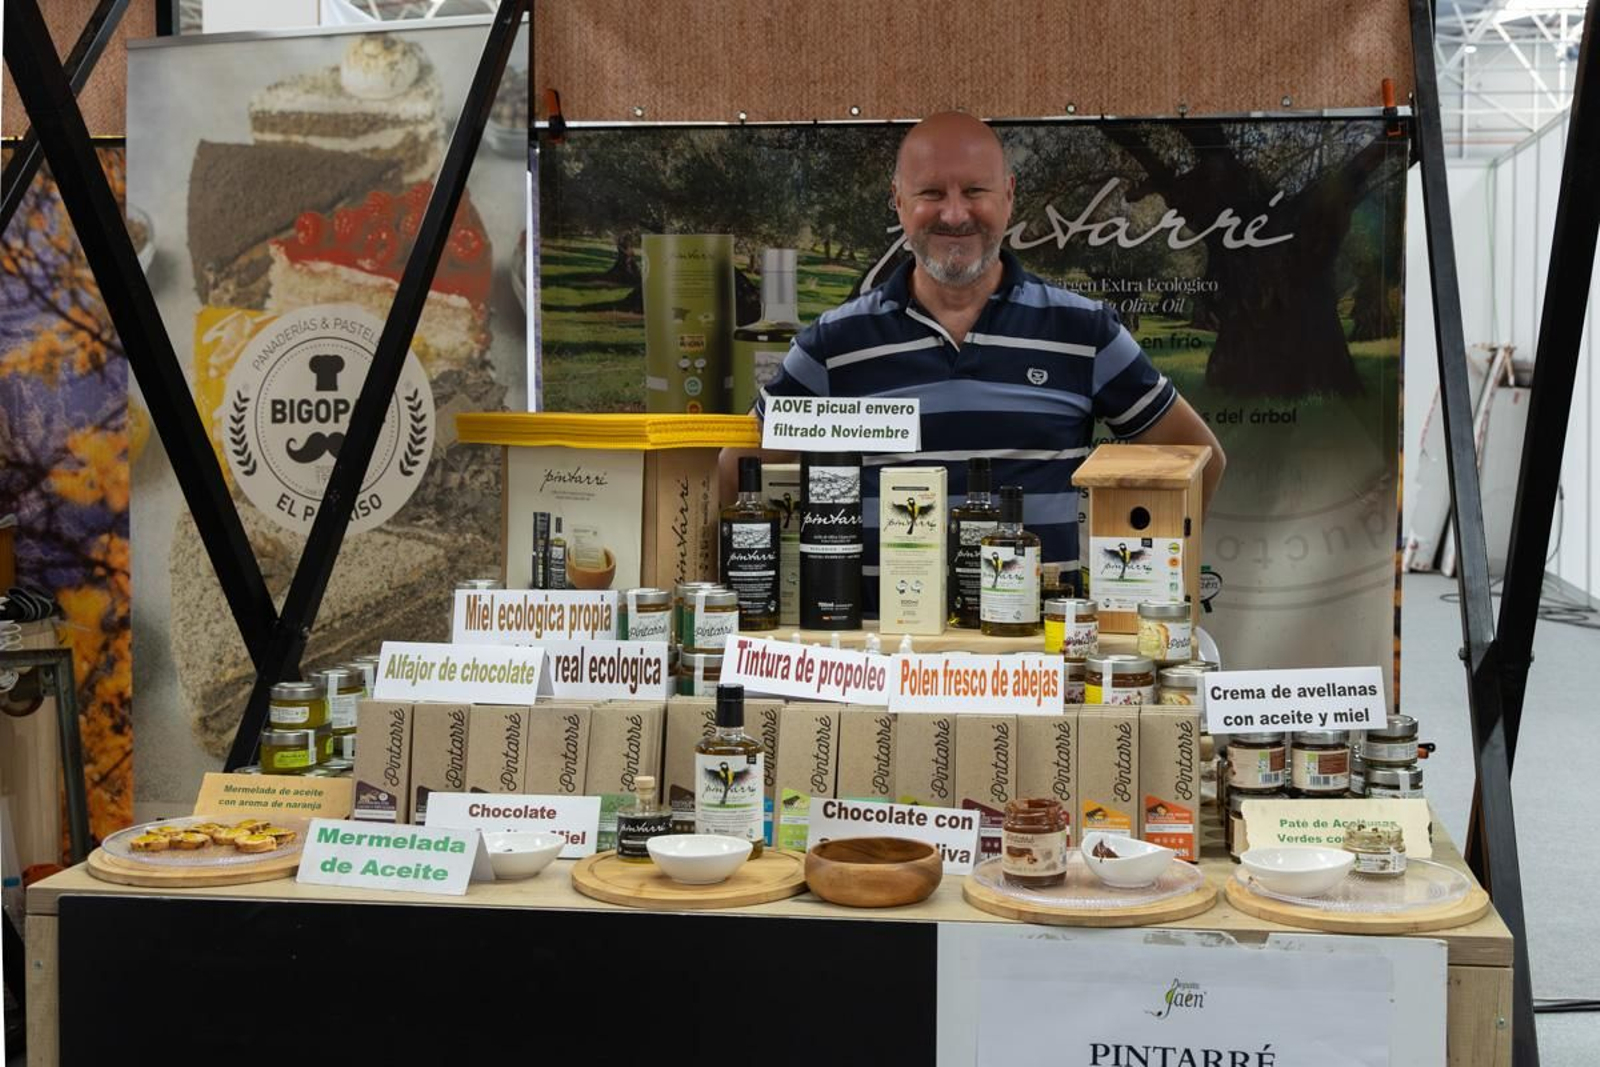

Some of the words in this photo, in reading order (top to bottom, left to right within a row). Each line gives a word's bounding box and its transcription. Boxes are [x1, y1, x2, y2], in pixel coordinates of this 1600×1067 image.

[1101, 278, 1142, 292] Extra
[1147, 277, 1219, 295] Ecológico
[1120, 299, 1159, 314] Olive
[1162, 299, 1186, 313] Oil
[320, 317, 330, 330] &
[1142, 335, 1163, 349] en
[1169, 332, 1202, 349] frío
[772, 399, 812, 414] AOVE
[816, 400, 861, 417] picual
[865, 402, 915, 416] envero
[1215, 408, 1244, 424] del
[1249, 407, 1298, 425] árbol
[773, 422, 826, 438] filtrado
[830, 424, 910, 440] Noviembre
[276, 493, 297, 518] EL
[464, 593, 495, 631] Miel
[497, 594, 565, 640] ecologica
[568, 594, 613, 640] propia
[384, 653, 437, 687] Alfajor
[438, 656, 457, 682] de
[460, 654, 536, 686] chocolate
[554, 646, 585, 684] real
[588, 647, 662, 695] ecologica
[735, 639, 790, 682] Tintura
[795, 651, 814, 684] de
[817, 656, 887, 697] propoleo
[899, 659, 939, 697] Polen
[942, 660, 988, 697] fresco
[991, 660, 1009, 697] de
[1012, 660, 1059, 707] abejas
[1210, 685, 1266, 701] Crema
[1271, 684, 1292, 700] de
[1296, 683, 1378, 698] avellanas
[1223, 713, 1254, 727] con
[1259, 710, 1314, 726] aceite
[1318, 711, 1329, 727] y
[1333, 708, 1370, 723] miel
[384, 707, 405, 788] Pintarré
[446, 709, 465, 789] Pintarré
[501, 711, 522, 792] Pintarré
[560, 713, 581, 793] Pintarré
[810, 714, 832, 794] Pintarré
[872, 715, 892, 795] Pintarré
[931, 718, 950, 800] Pintarré
[1053, 720, 1071, 801] Pintarré
[1175, 719, 1194, 801] Pintarré
[1114, 721, 1132, 802] Pintarré
[223, 784, 277, 795] Mermelada
[279, 787, 291, 796] de
[293, 788, 324, 797] aceite
[238, 800, 269, 808] aroma
[271, 799, 283, 808] de
[285, 801, 322, 811] naranja
[468, 803, 558, 820] Chocolate
[822, 800, 928, 827] Chocolate
[934, 814, 974, 831] con
[1312, 818, 1329, 829] de
[316, 827, 467, 854] Mermelada
[550, 829, 586, 845] iel
[1276, 833, 1323, 844] Verdes
[933, 842, 971, 864] liva
[320, 856, 353, 874] de
[360, 859, 449, 882] Aceite
